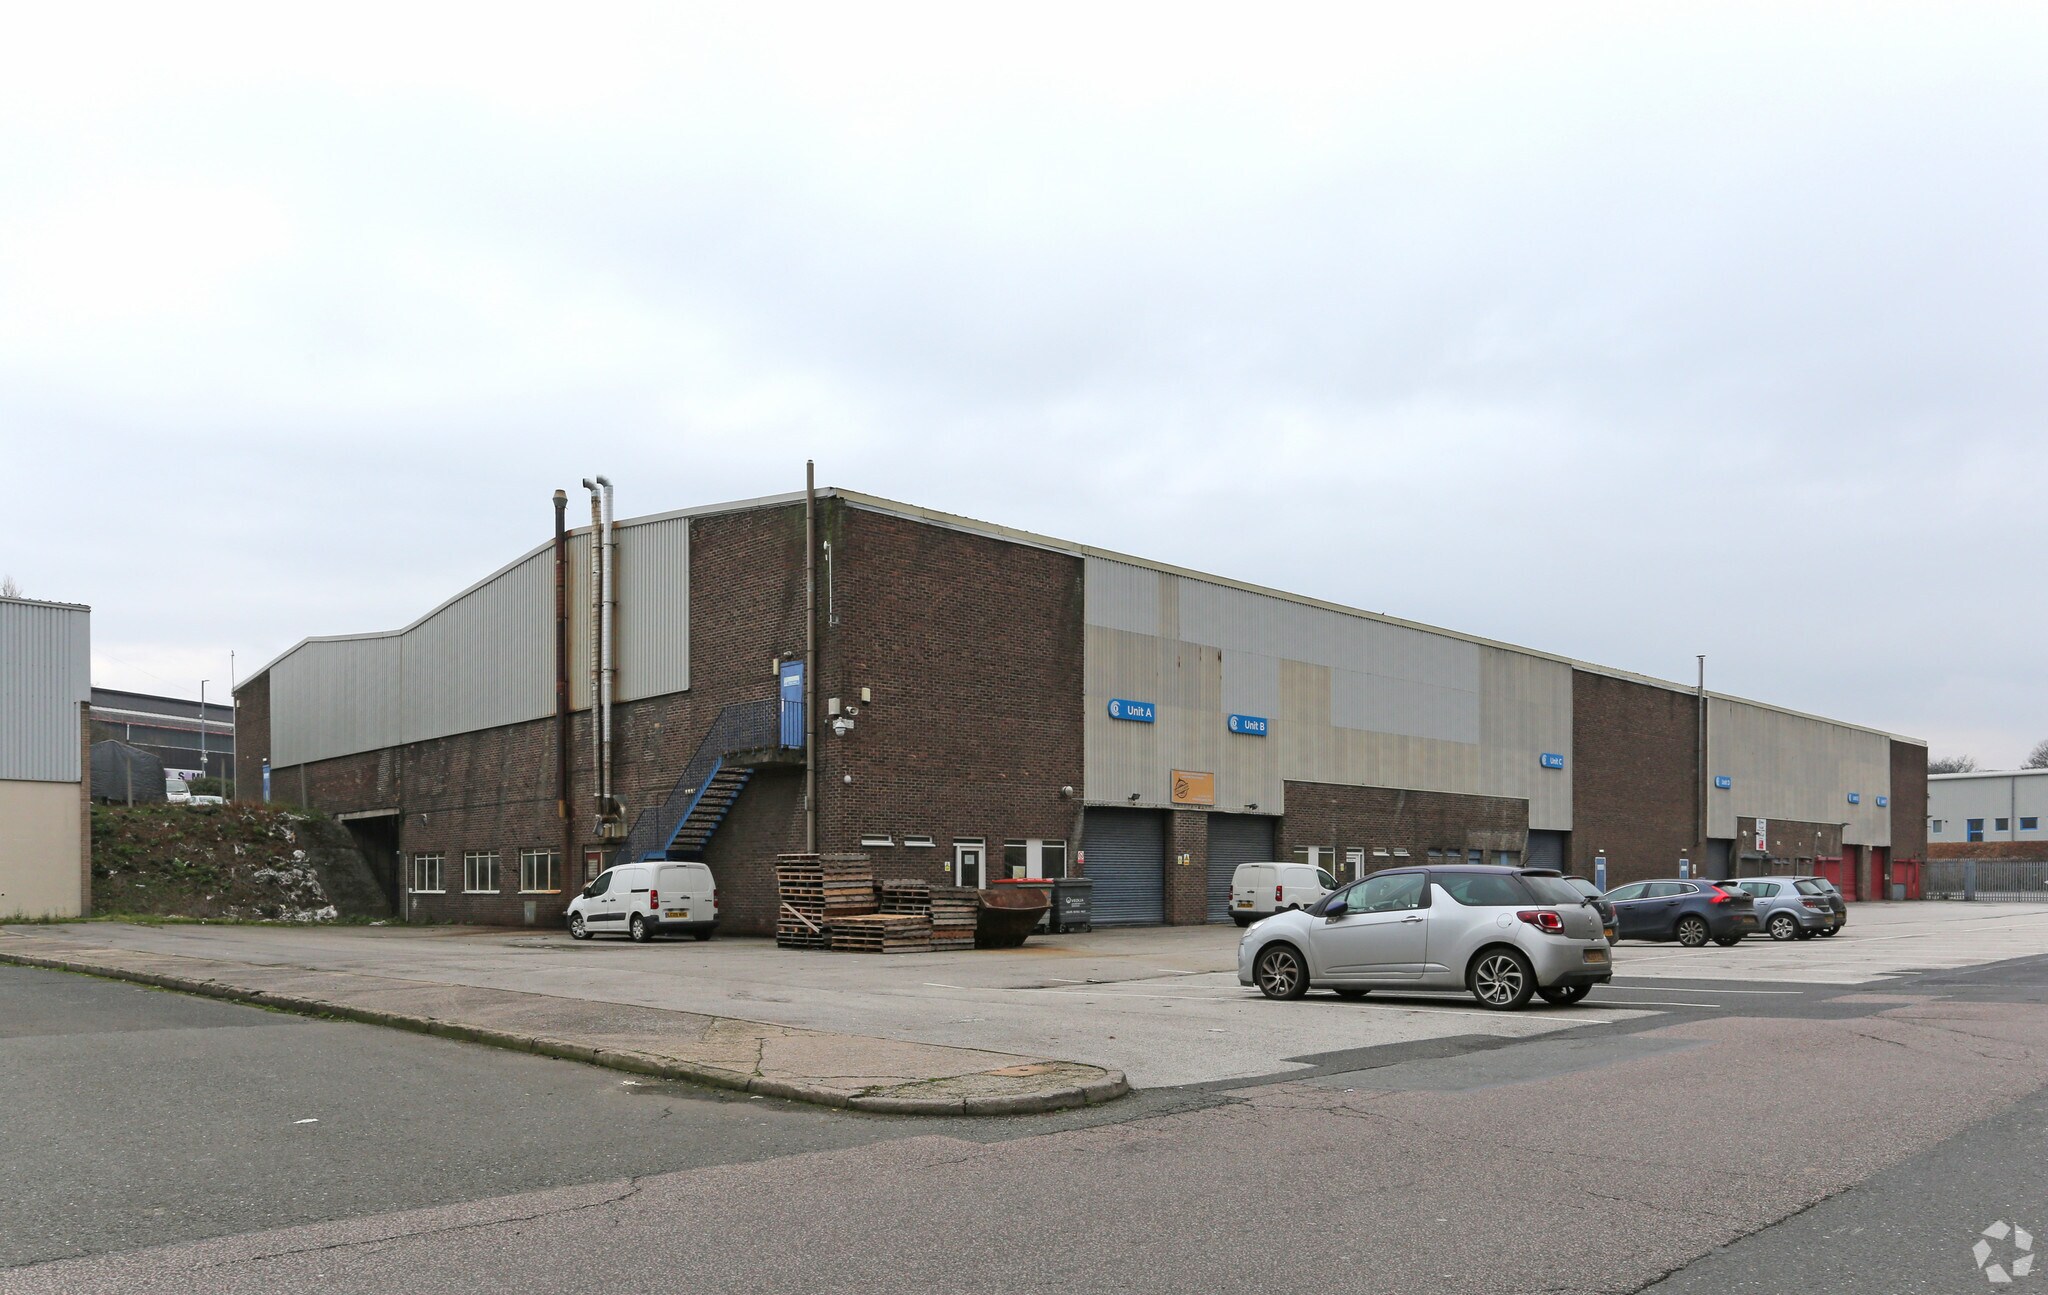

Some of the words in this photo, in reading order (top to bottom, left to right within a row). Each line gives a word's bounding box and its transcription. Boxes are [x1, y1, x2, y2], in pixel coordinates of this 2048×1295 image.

[1127, 705, 1144, 717] Unit
[1145, 708, 1153, 718] A
[1244, 720, 1259, 731] Unit
[1259, 722, 1265, 731] B
[1550, 757, 1558, 765] Unit
